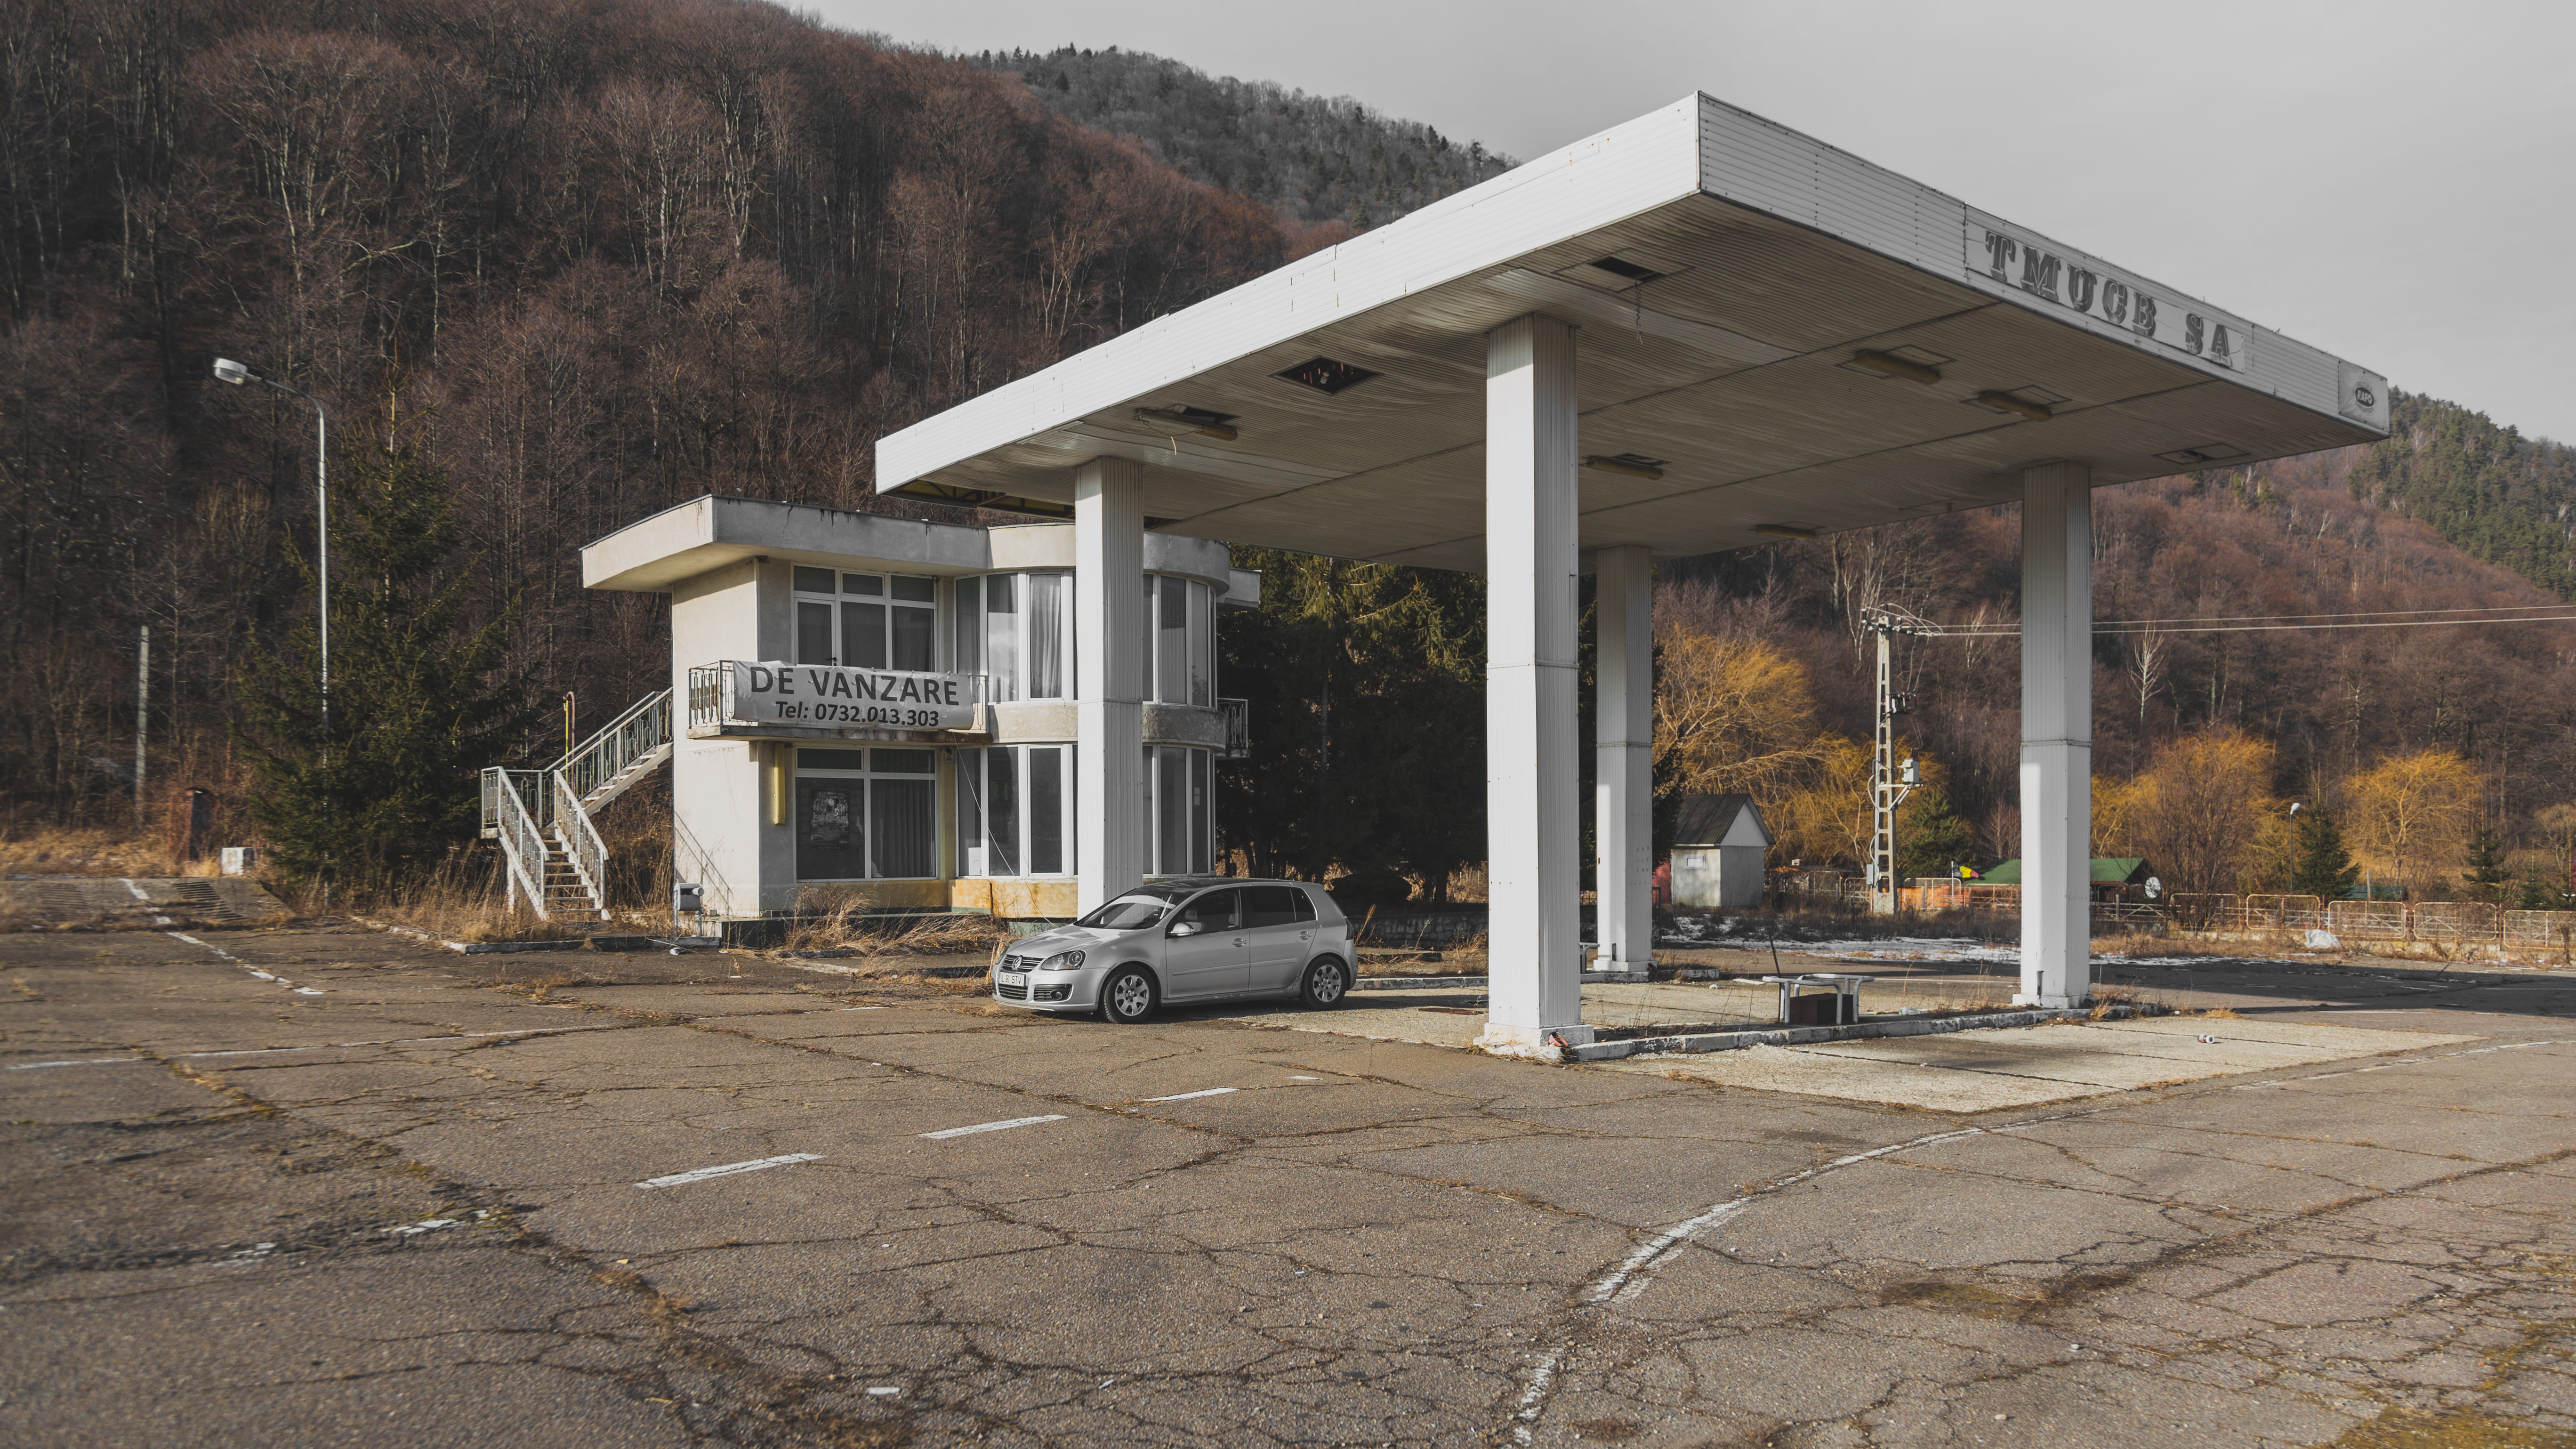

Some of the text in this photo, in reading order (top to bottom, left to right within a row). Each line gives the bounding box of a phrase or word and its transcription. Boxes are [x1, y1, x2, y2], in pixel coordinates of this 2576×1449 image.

[2185, 313, 2233, 367] SA
[2357, 389, 2373, 404] RAFO
[750, 666, 959, 706] DE VANZARE
[775, 701, 939, 727] Tel: 0732.013.303
[1006, 974, 1010, 983] 91
[1012, 975, 1022, 984] STV
